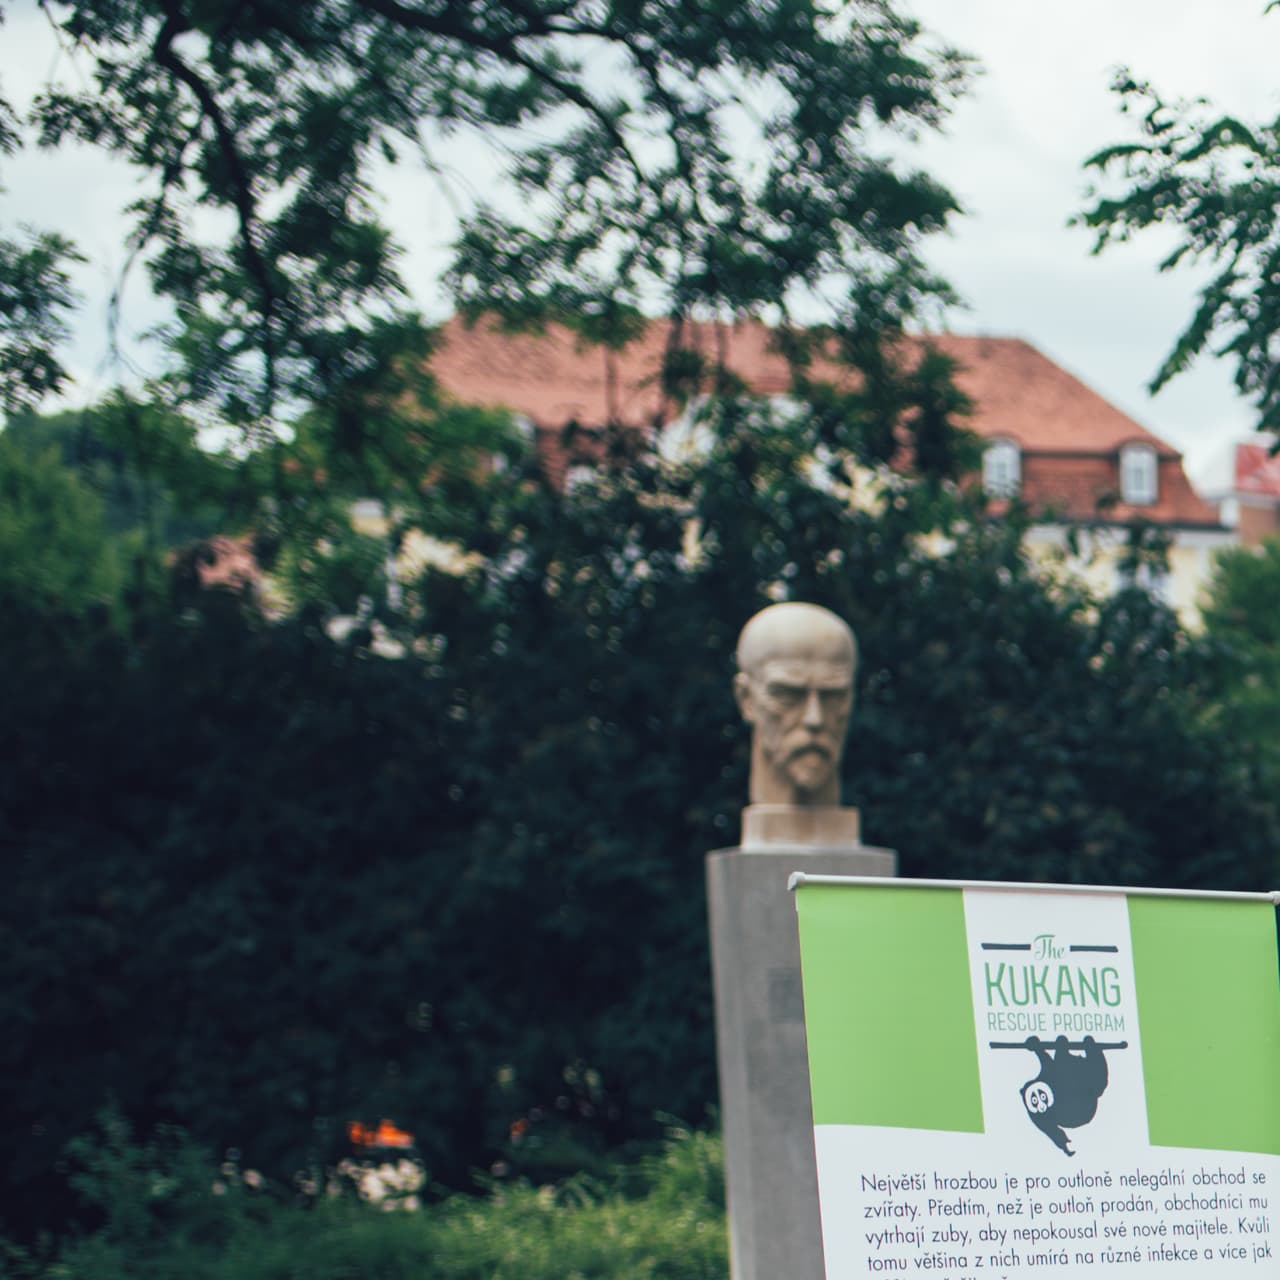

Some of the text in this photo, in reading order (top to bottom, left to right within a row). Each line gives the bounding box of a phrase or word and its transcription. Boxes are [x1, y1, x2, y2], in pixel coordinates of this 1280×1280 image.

[1033, 933, 1066, 961] The
[984, 961, 1121, 1008] KUKANG
[987, 1012, 1125, 1032] RESCUE PROGRAM
[861, 1166, 1266, 1197] Největší hrozbou je pro outloně nelegální obchod se
[864, 1192, 1268, 1222] zvířaty. Předtím, než je outloň prodán, obchodníci mu
[865, 1216, 1269, 1250] vytrhají zuby, aby nepokousal své nové majitele. Kvůli
[868, 1240, 1272, 1271] tomu většina z nich umírá na různé infekce a více jak
